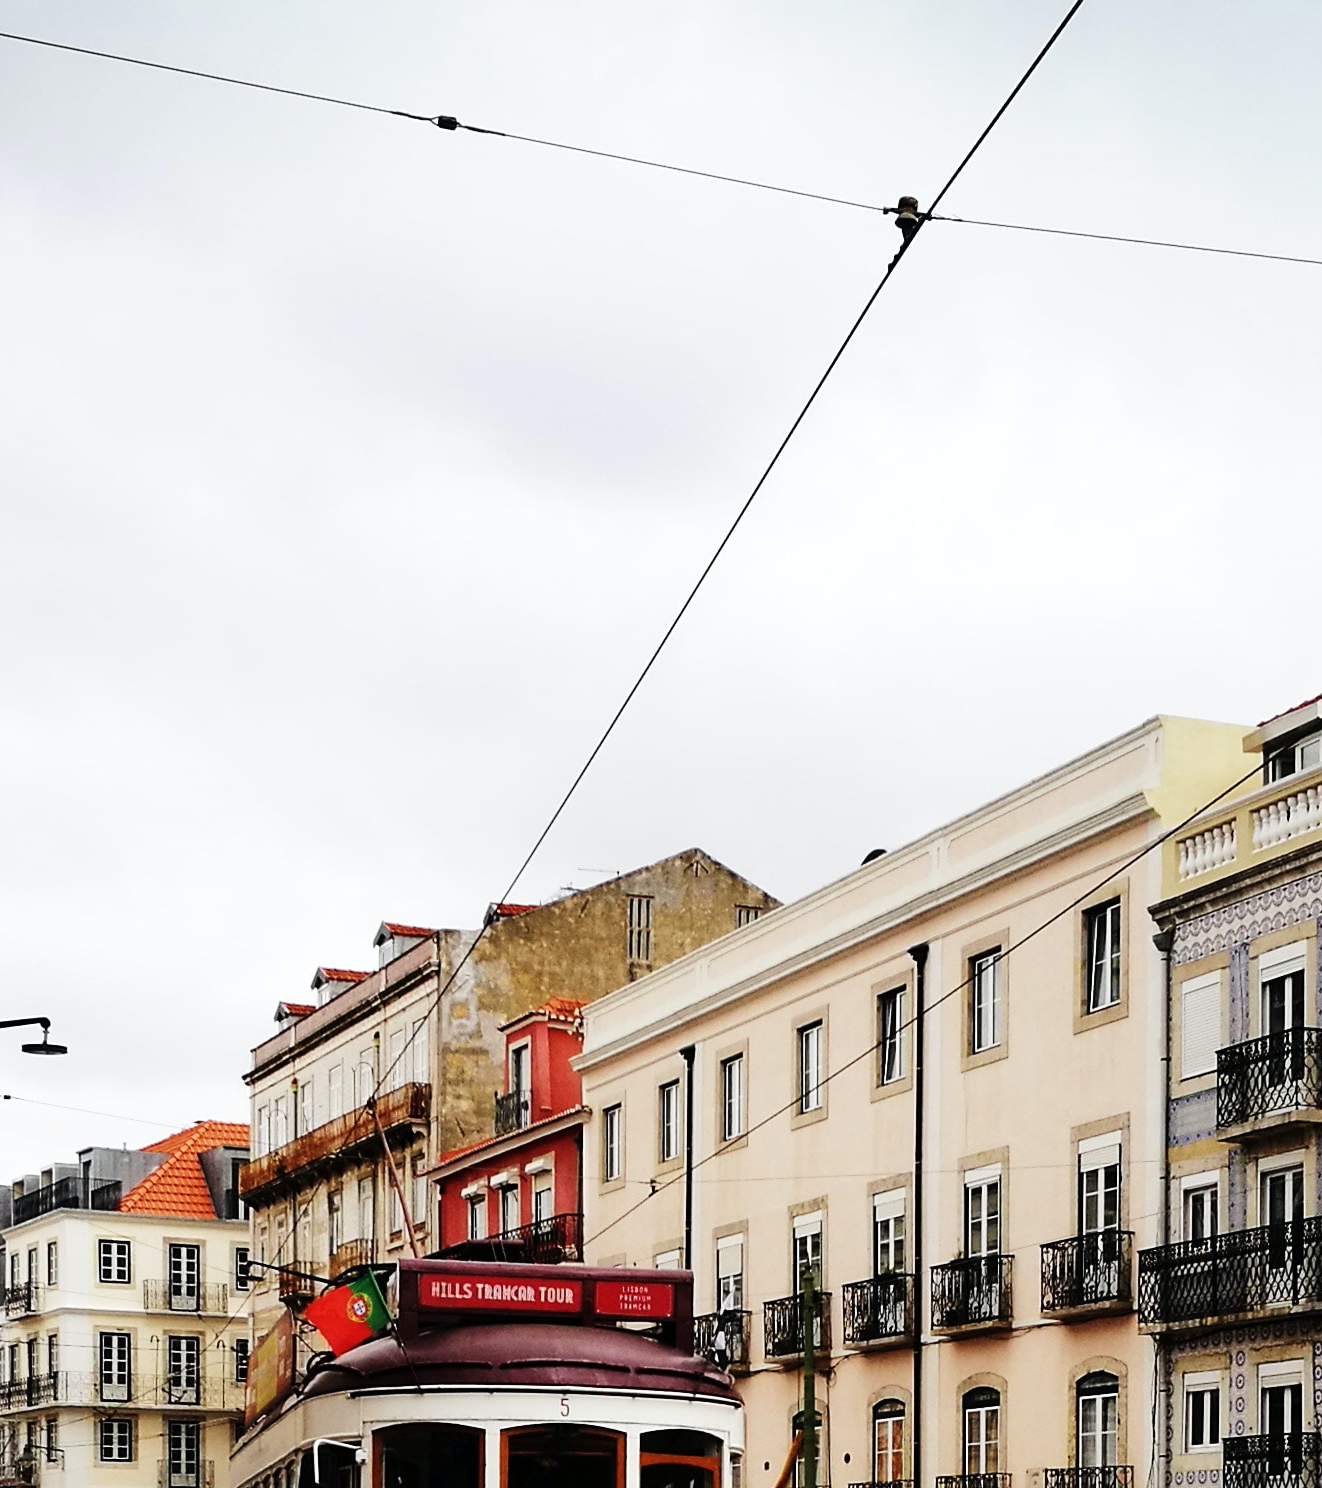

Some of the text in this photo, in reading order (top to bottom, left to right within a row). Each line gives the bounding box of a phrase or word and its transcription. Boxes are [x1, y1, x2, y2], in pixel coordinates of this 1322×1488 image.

[431, 1281, 574, 1304] HILLS TRAMCAR TOUR
[622, 1285, 649, 1294] LISBON
[619, 1294, 652, 1302] PREMIUM
[560, 1397, 570, 1417] 5
